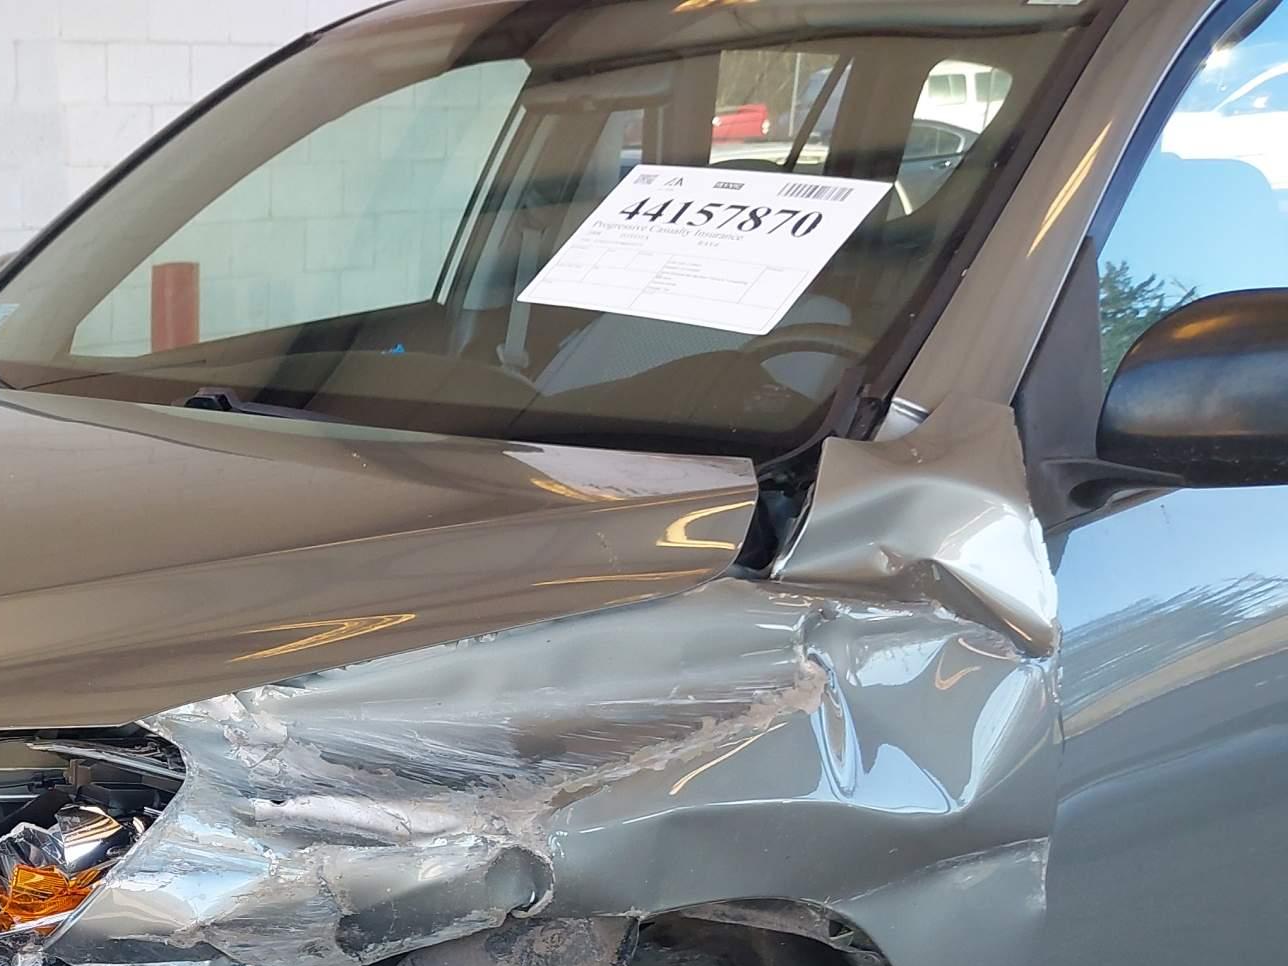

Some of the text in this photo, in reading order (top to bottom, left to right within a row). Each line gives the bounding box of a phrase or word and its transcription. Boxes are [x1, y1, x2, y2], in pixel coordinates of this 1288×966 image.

[592, 219, 648, 233] Progressive
[649, 223, 692, 238] Casualty
[693, 225, 745, 241] Insurance
[620, 197, 823, 238] 44157870
